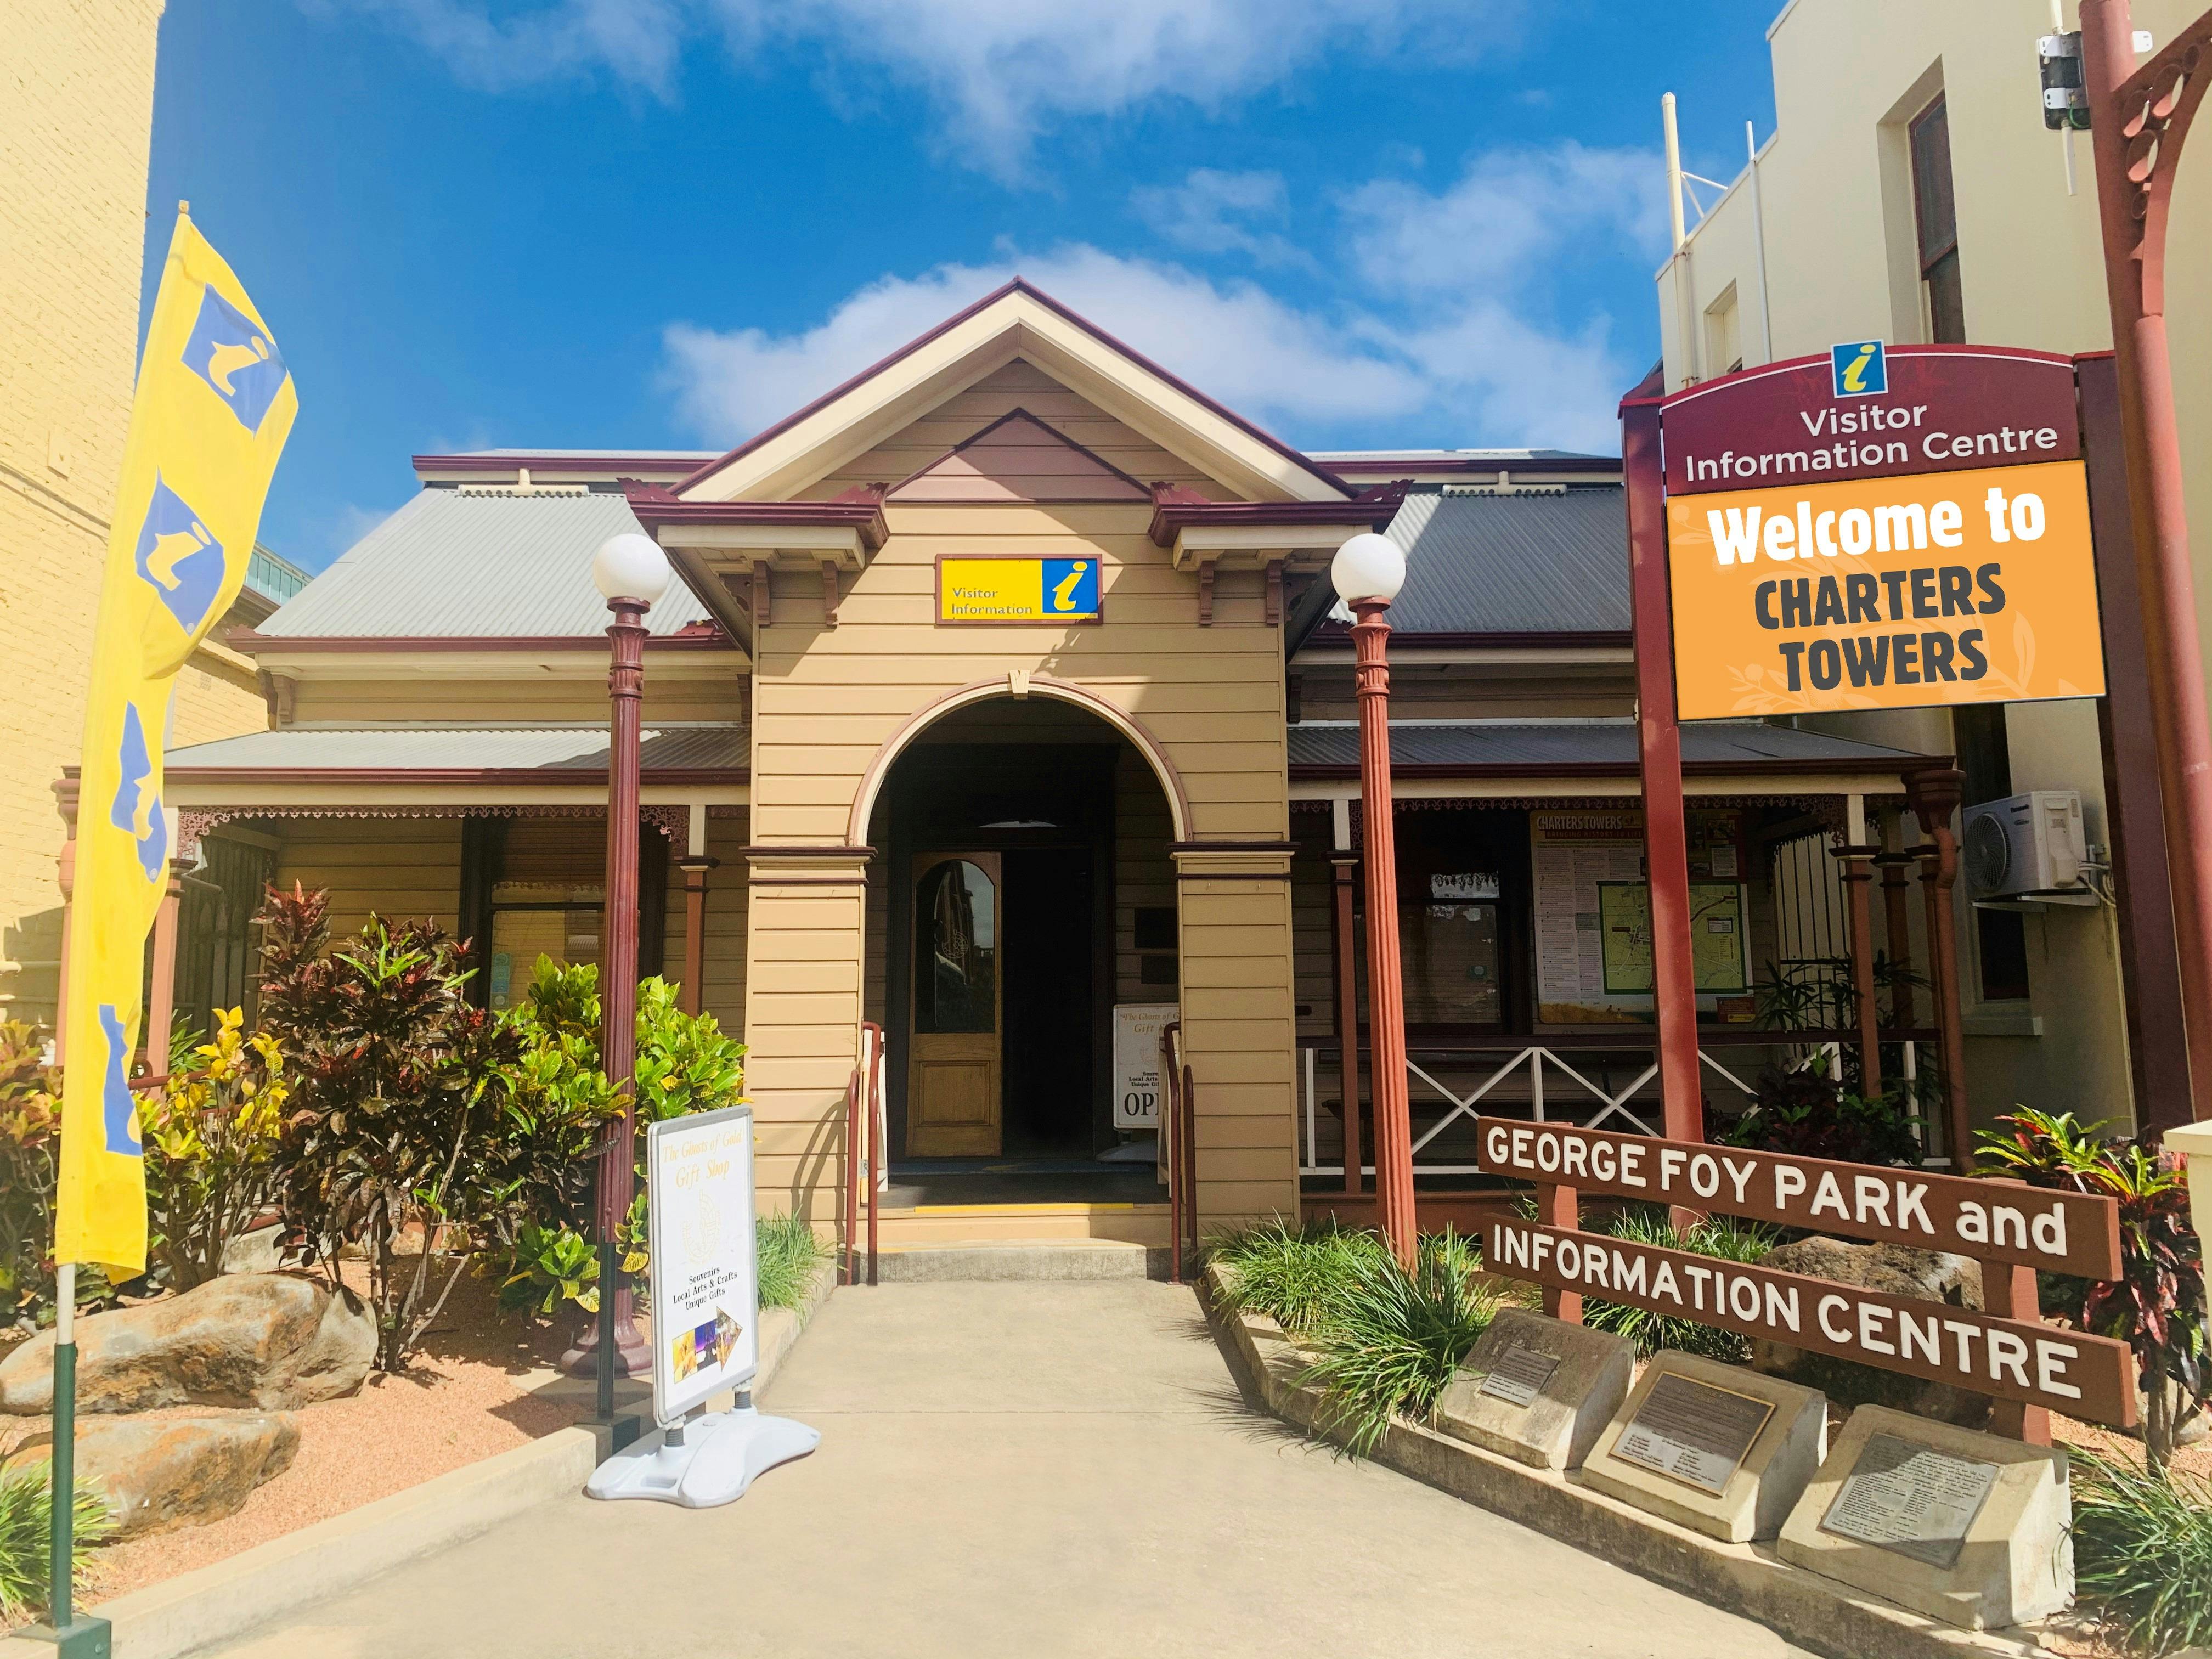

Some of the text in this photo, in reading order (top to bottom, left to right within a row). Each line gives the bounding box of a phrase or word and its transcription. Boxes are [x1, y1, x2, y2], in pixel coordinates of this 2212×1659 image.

[1801, 405, 1927, 437] Visitor
[1687, 427, 2058, 482] Information Centre
[1707, 488, 2045, 565] Welcome to
[952, 588, 998, 598] Visitor
[952, 603, 1032, 614] Information
[1756, 563, 2006, 629] CHARTERS
[1779, 629, 1988, 692] TOWERS
[1134, 1023, 1154, 1036] Gift
[662, 1128, 742, 1163] The Ghosts of Gold
[675, 1158, 730, 1190] Gift Shop
[1487, 1126, 2067, 1256] GEORGE FOY PARK and
[673, 1272, 737, 1304] Local Arts & Crafts
[689, 1267, 720, 1285] Souvenirs
[686, 1288, 725, 1310] Unique Gifts
[1493, 1224, 2082, 1399] INFORMATION CENTRE
